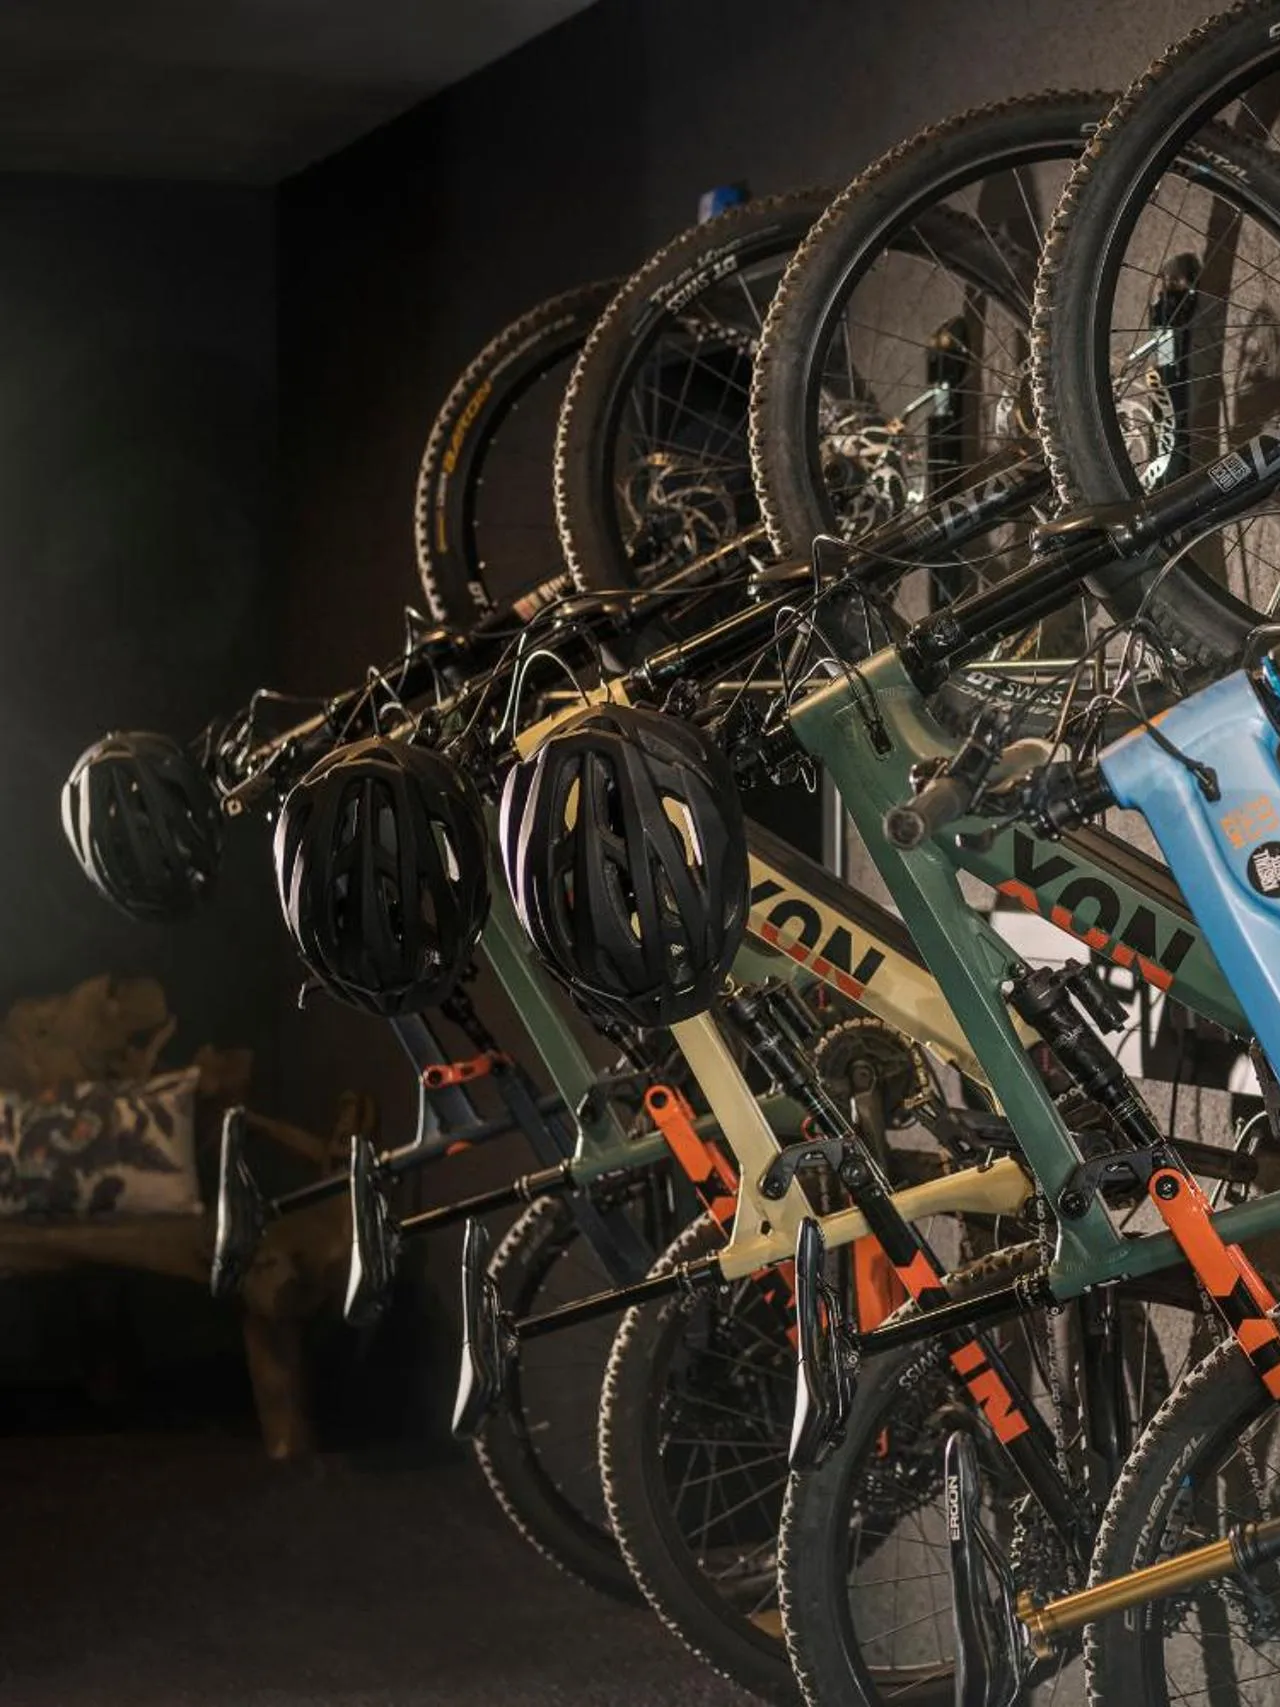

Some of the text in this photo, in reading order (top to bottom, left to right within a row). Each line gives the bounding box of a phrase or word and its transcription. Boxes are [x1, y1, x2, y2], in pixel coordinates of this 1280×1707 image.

[966, 670, 1064, 706] DT SWSS
[948, 1475, 960, 1541] ERGON
